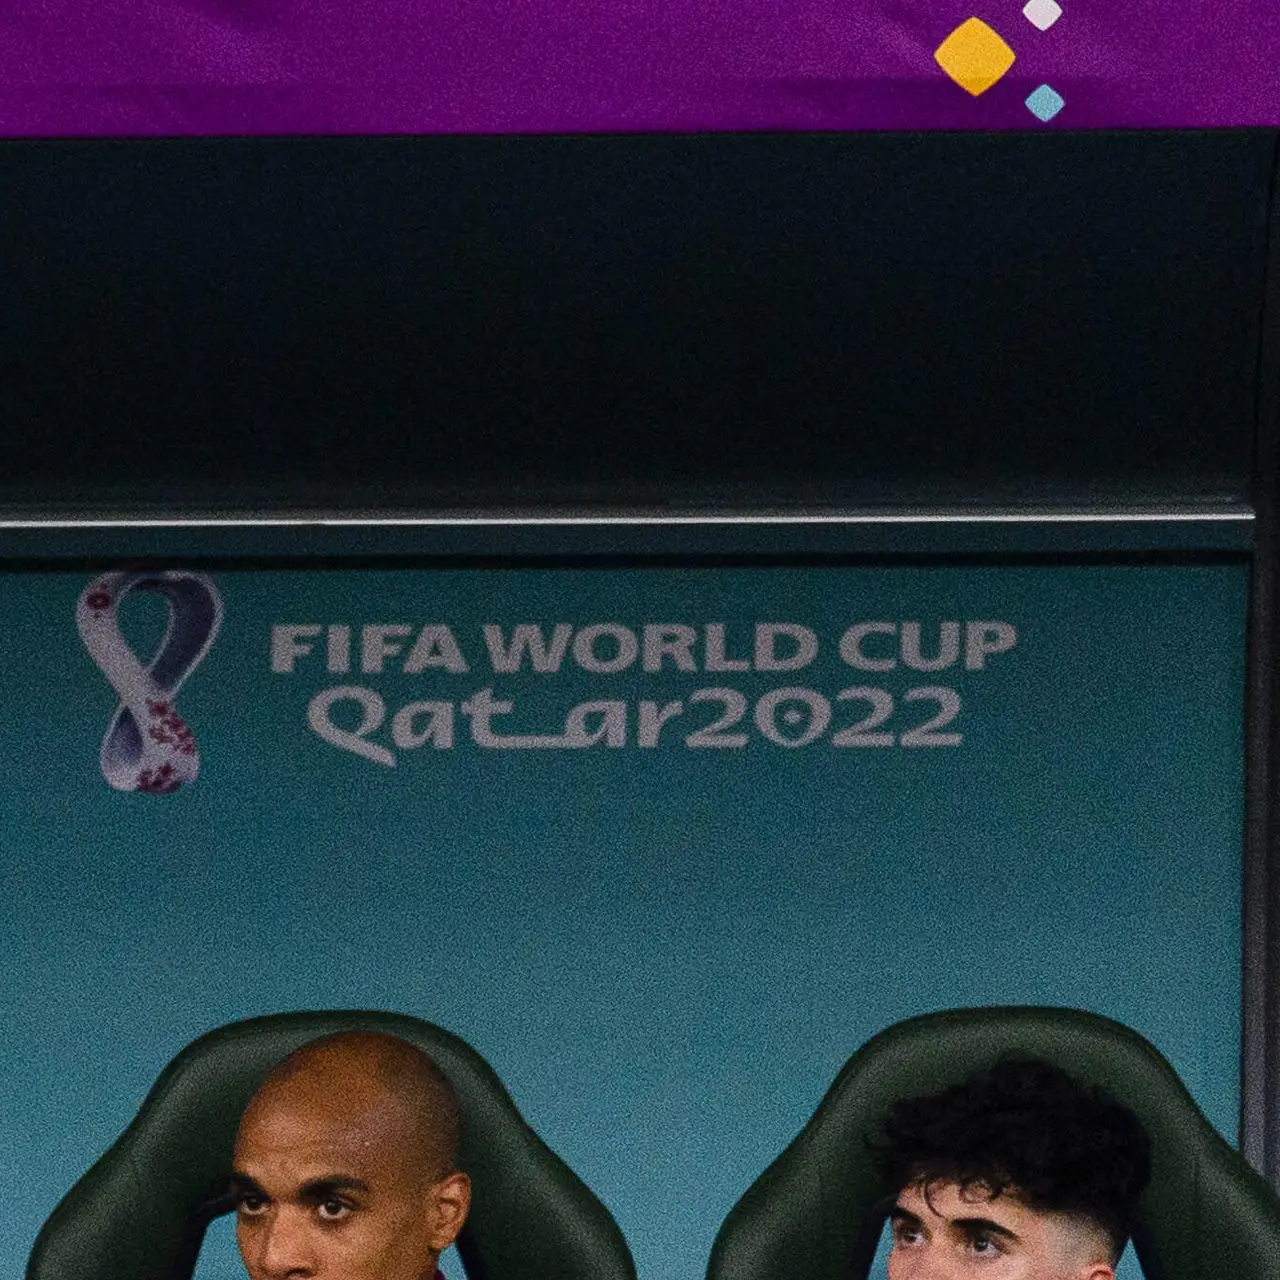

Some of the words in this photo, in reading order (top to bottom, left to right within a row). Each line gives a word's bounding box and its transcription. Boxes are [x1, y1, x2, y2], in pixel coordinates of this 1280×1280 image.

[271, 624, 469, 674] FIFA
[483, 623, 819, 674] WORLD
[838, 621, 1018, 671] CUP
[306, 684, 964, 768] Qatar2022
